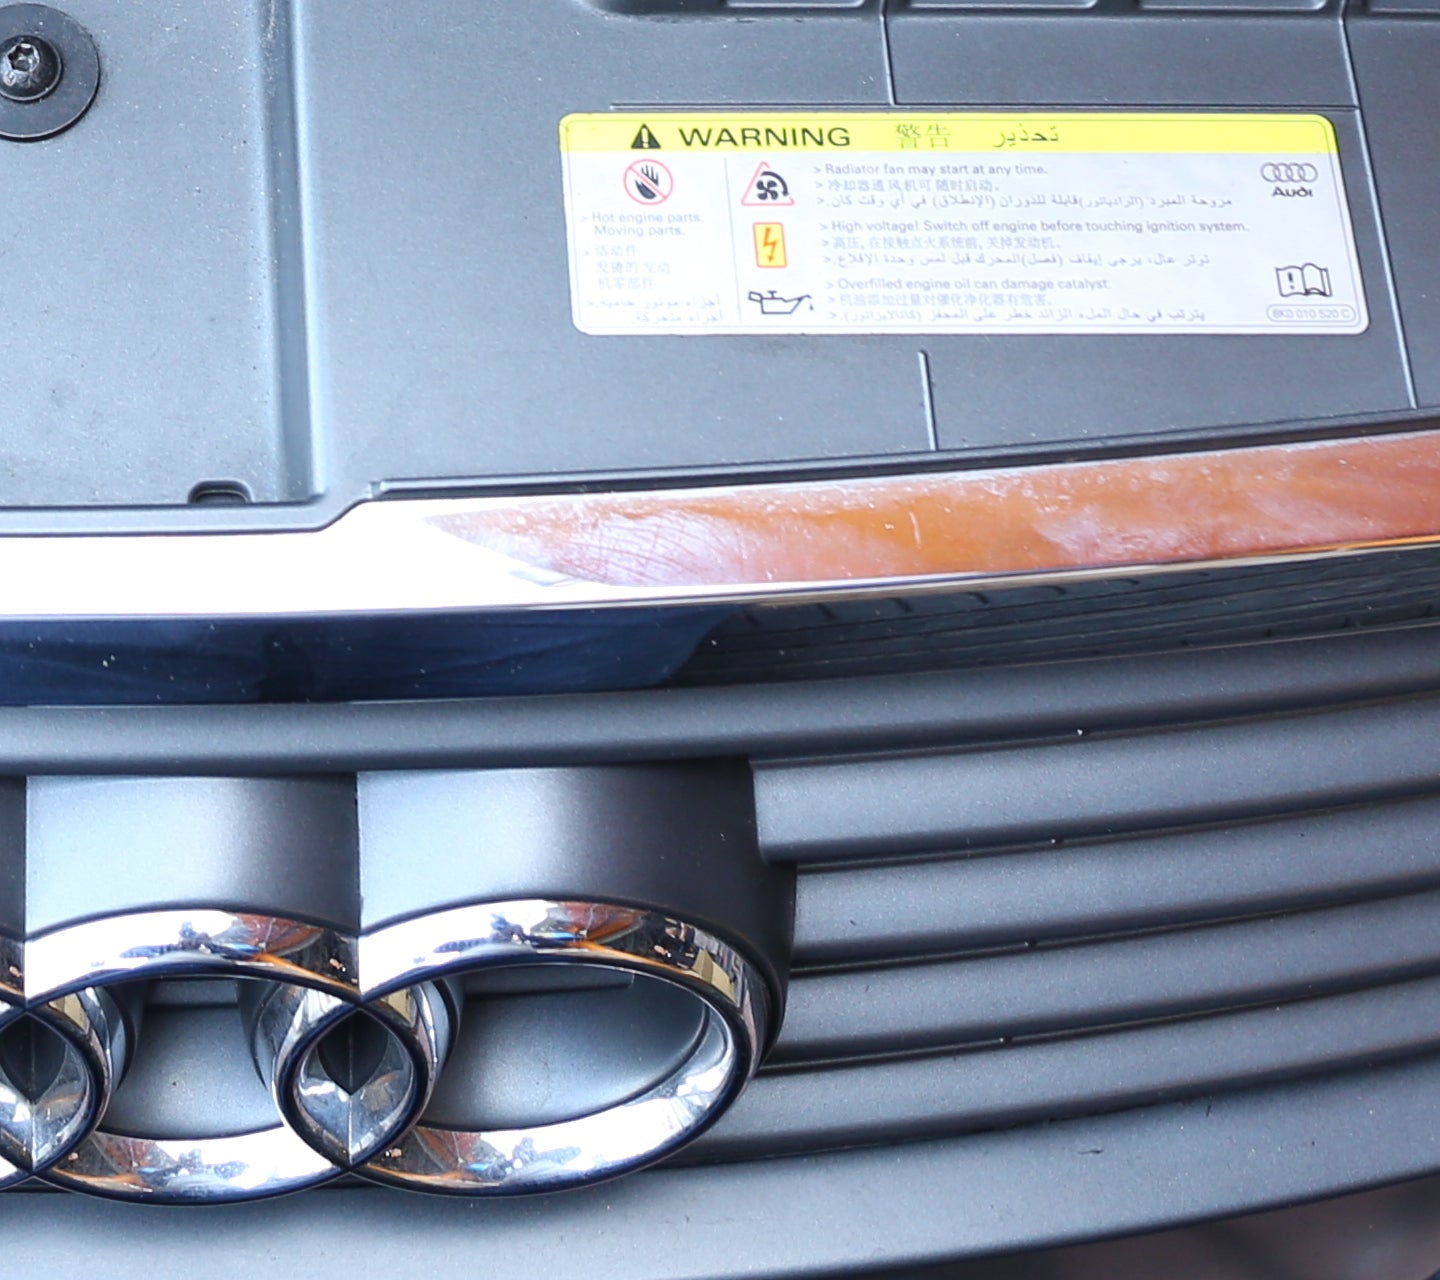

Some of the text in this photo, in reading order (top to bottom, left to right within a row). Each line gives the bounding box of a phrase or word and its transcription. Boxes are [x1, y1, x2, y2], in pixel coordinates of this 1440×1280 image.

[678, 123, 1060, 150] WARNING 警告 تحذير
[825, 163, 1049, 177] Radiator fan may start at any time.
[1271, 186, 1314, 198] Audi
[592, 211, 705, 225] Hot engine parts.
[594, 225, 686, 238] Moving parts.
[831, 220, 1251, 234] High voltage! Switch off engine before touching ignition system.
[837, 278, 1113, 292] Overfilled engine oil can damage catalyst.
[1295, 309, 1317, 319] 010
